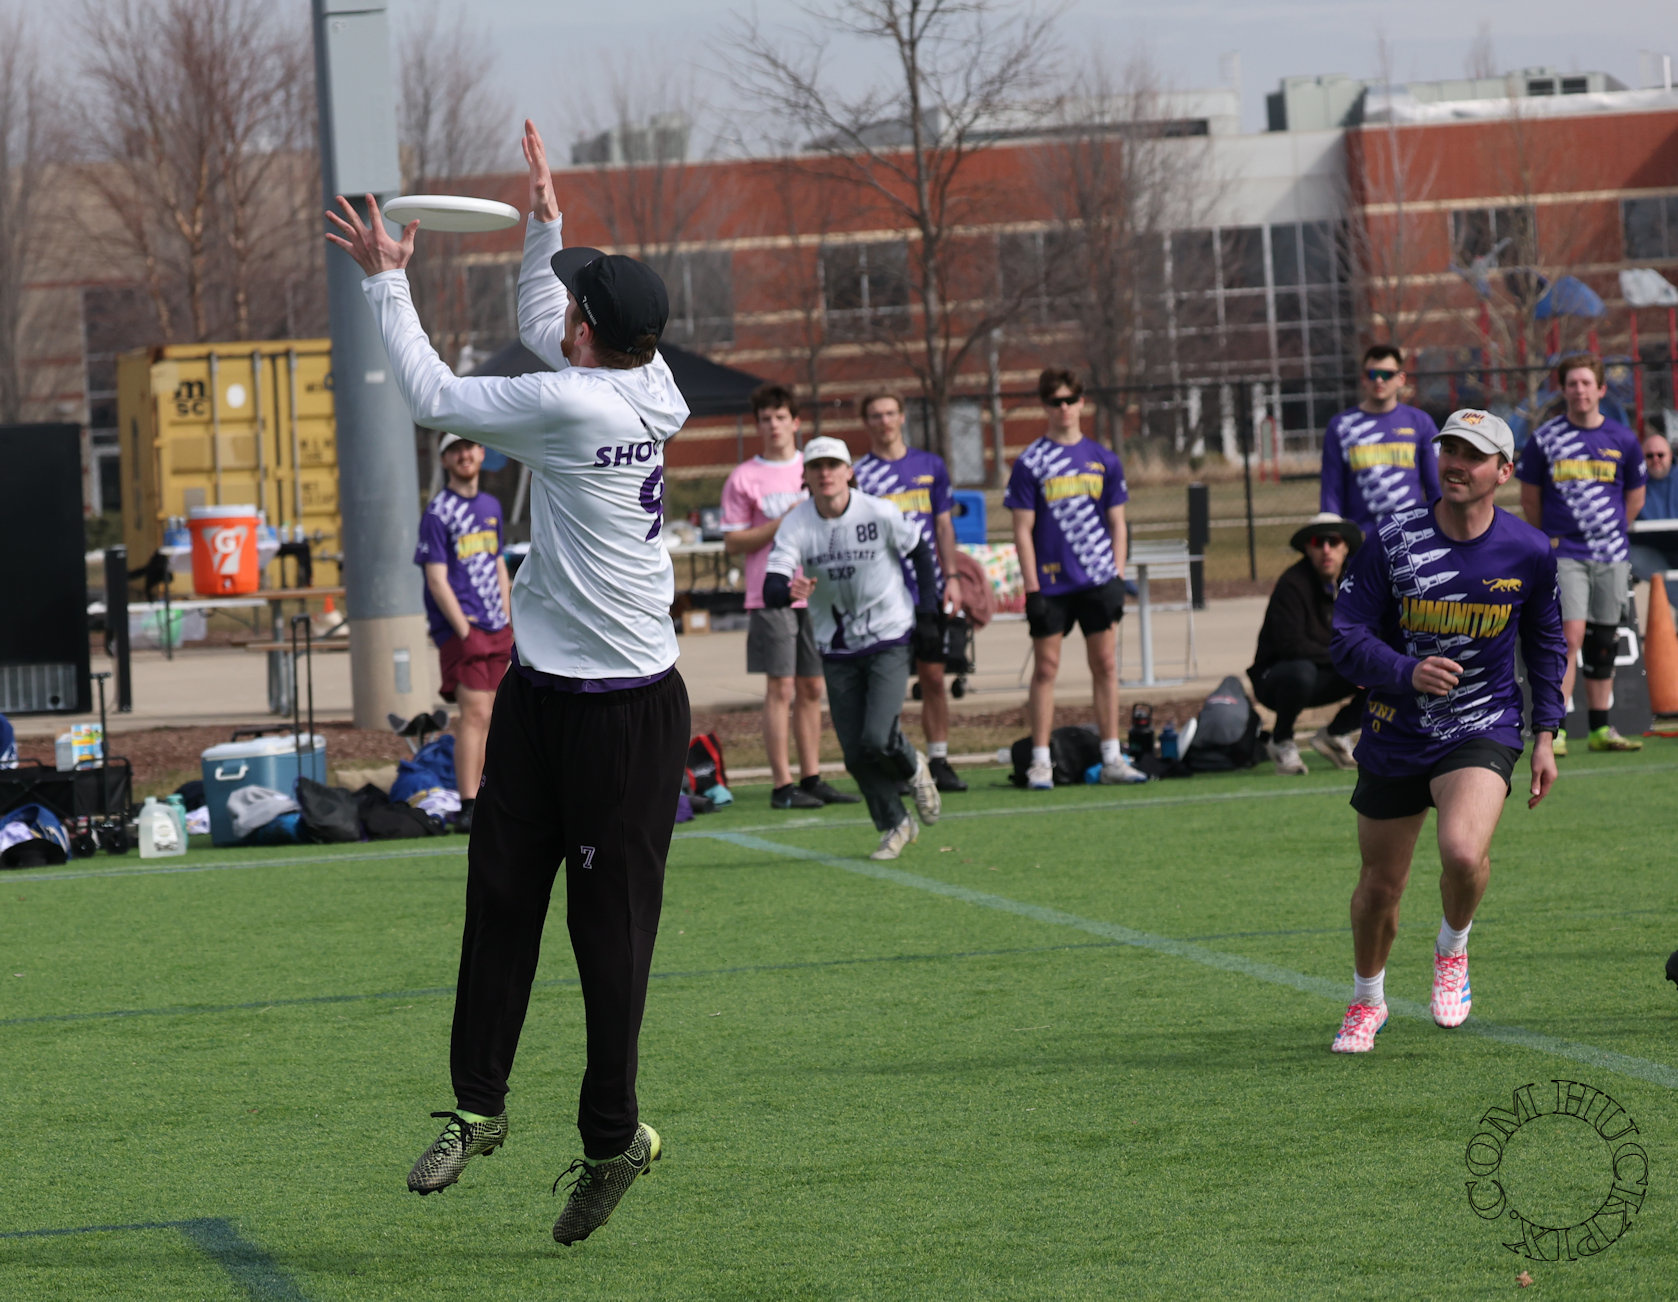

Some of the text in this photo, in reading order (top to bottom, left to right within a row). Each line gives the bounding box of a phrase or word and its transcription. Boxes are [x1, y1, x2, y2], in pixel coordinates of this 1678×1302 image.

[593, 441, 658, 468] SHO
[856, 522, 878, 544] 88
[845, 549, 876, 561] STATE
[827, 565, 856, 581] EXP
[1400, 596, 1513, 639] AMMUNITION
[1368, 701, 1397, 723] UNI
[580, 845, 596, 870] 7
